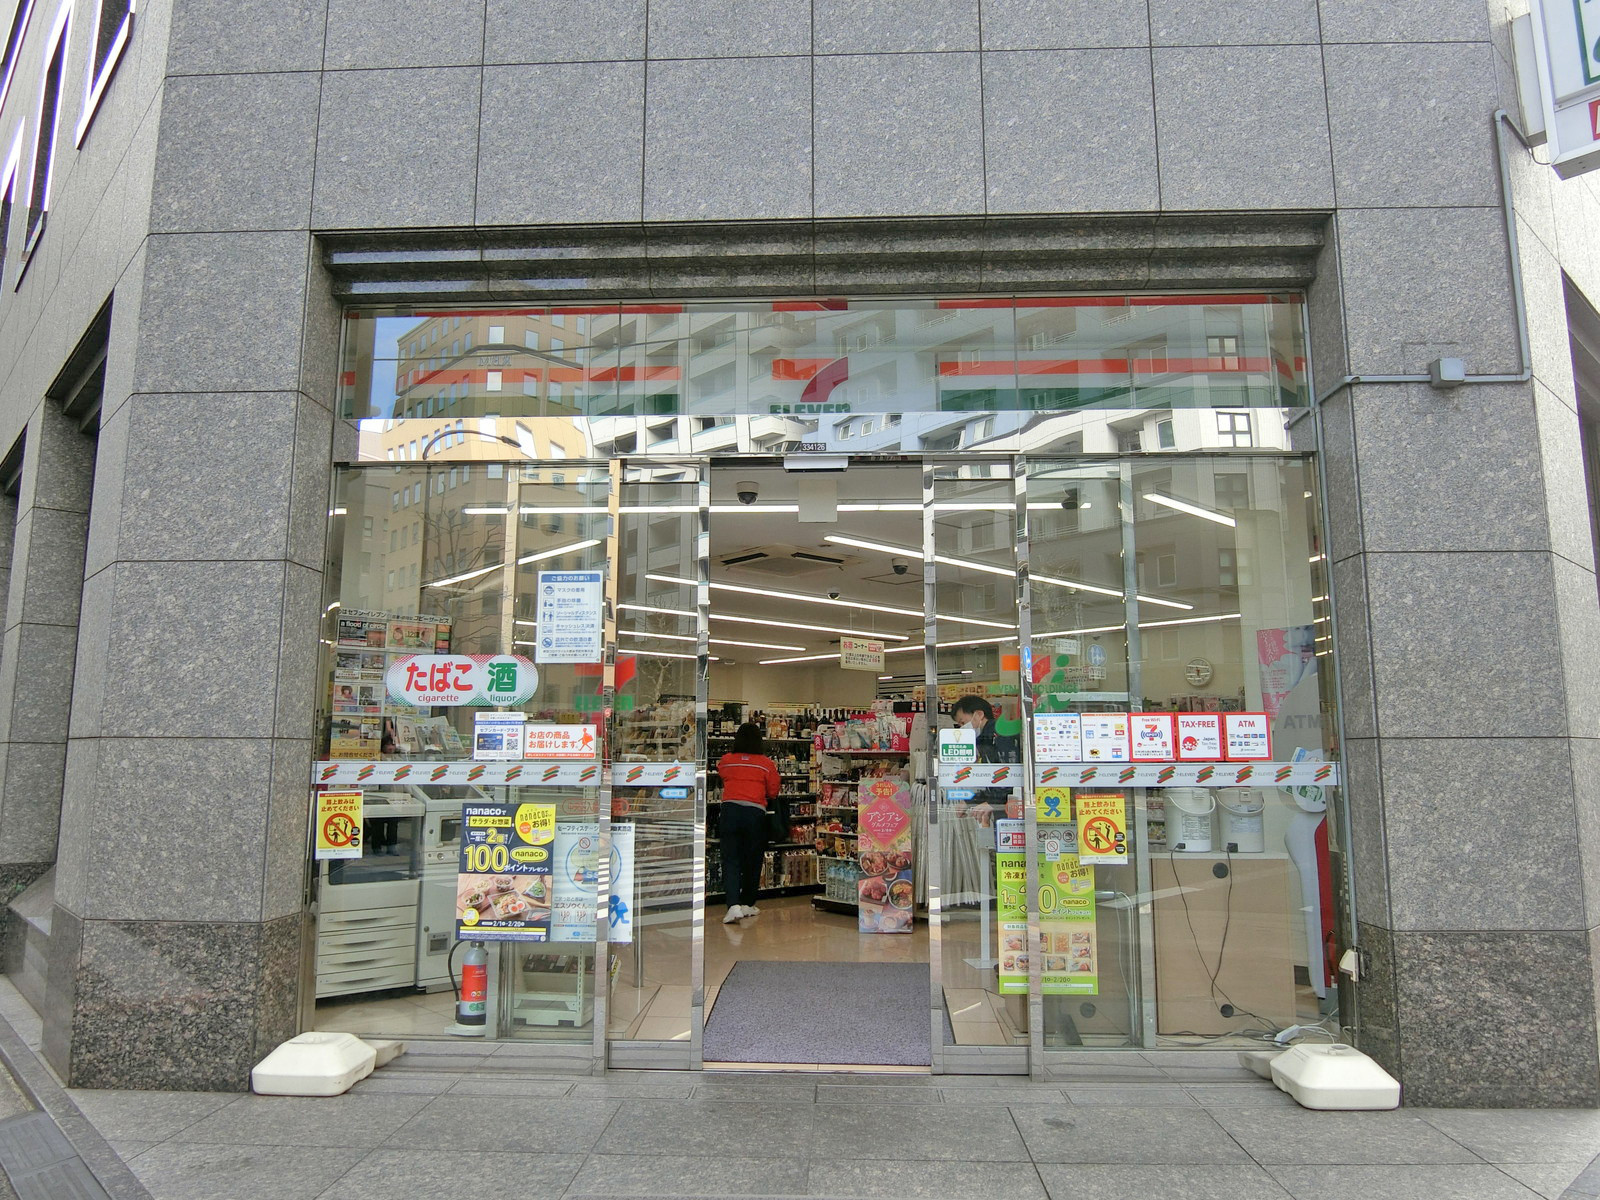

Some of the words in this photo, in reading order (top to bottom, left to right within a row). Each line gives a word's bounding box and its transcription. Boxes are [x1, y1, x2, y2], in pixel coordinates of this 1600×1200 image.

[405, 661, 473, 692] たばこ
[487, 662, 517, 692] 酒
[418, 694, 459, 702] cigarette
[489, 694, 517, 702] liquor
[529, 731, 570, 739] お店の商品
[464, 844, 509, 872] 100
[1071, 869, 1089, 878] お得!
